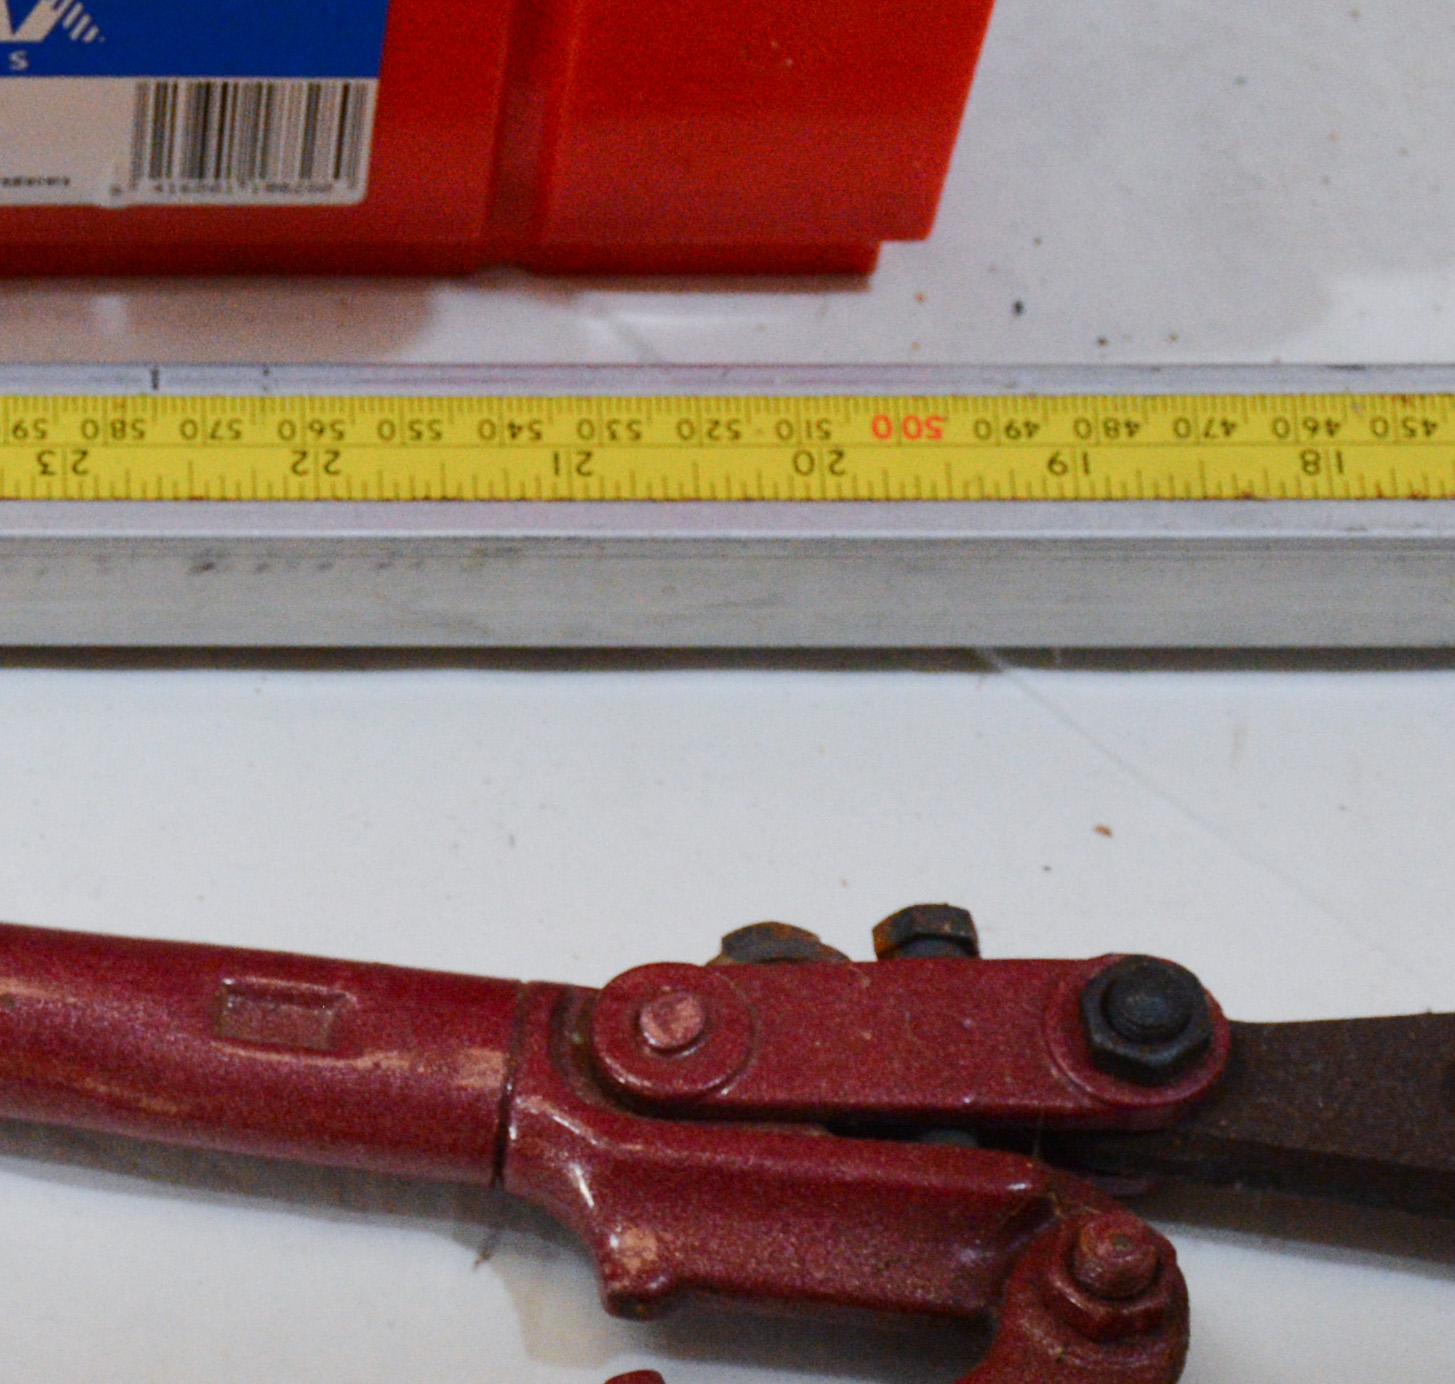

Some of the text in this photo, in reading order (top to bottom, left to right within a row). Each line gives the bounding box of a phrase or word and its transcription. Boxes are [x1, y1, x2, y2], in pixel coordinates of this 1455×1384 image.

[35, 449, 91, 476] 23
[290, 449, 343, 476] 22
[551, 450, 595, 477] 21
[792, 449, 848, 477] 20
[1046, 449, 1091, 476] 19
[1299, 449, 1346, 476] 18
